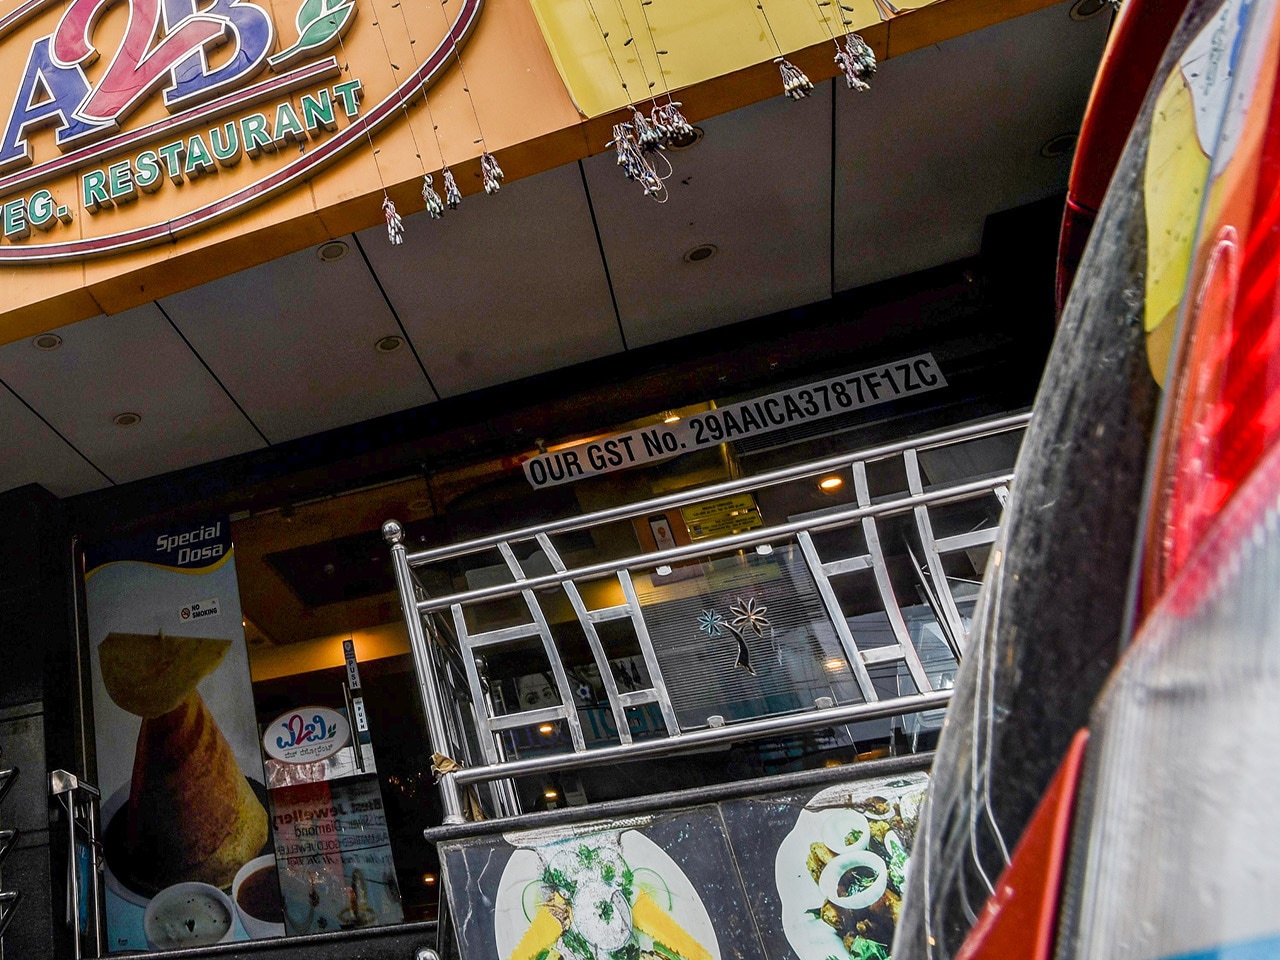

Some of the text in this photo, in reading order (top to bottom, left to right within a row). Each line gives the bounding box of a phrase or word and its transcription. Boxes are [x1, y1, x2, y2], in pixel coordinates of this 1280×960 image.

[82, 79, 365, 214] RESTAURANT
[528, 358, 940, 487] OUR GST No. 29AAICA3787F1ZC
[156, 521, 221, 552] Special
[177, 543, 224, 565] Dosa
[191, 603, 200, 611] NO
[192, 607, 218, 618] SMOKING
[348, 659, 359, 688] PUSH
[357, 706, 366, 730] PUSH
